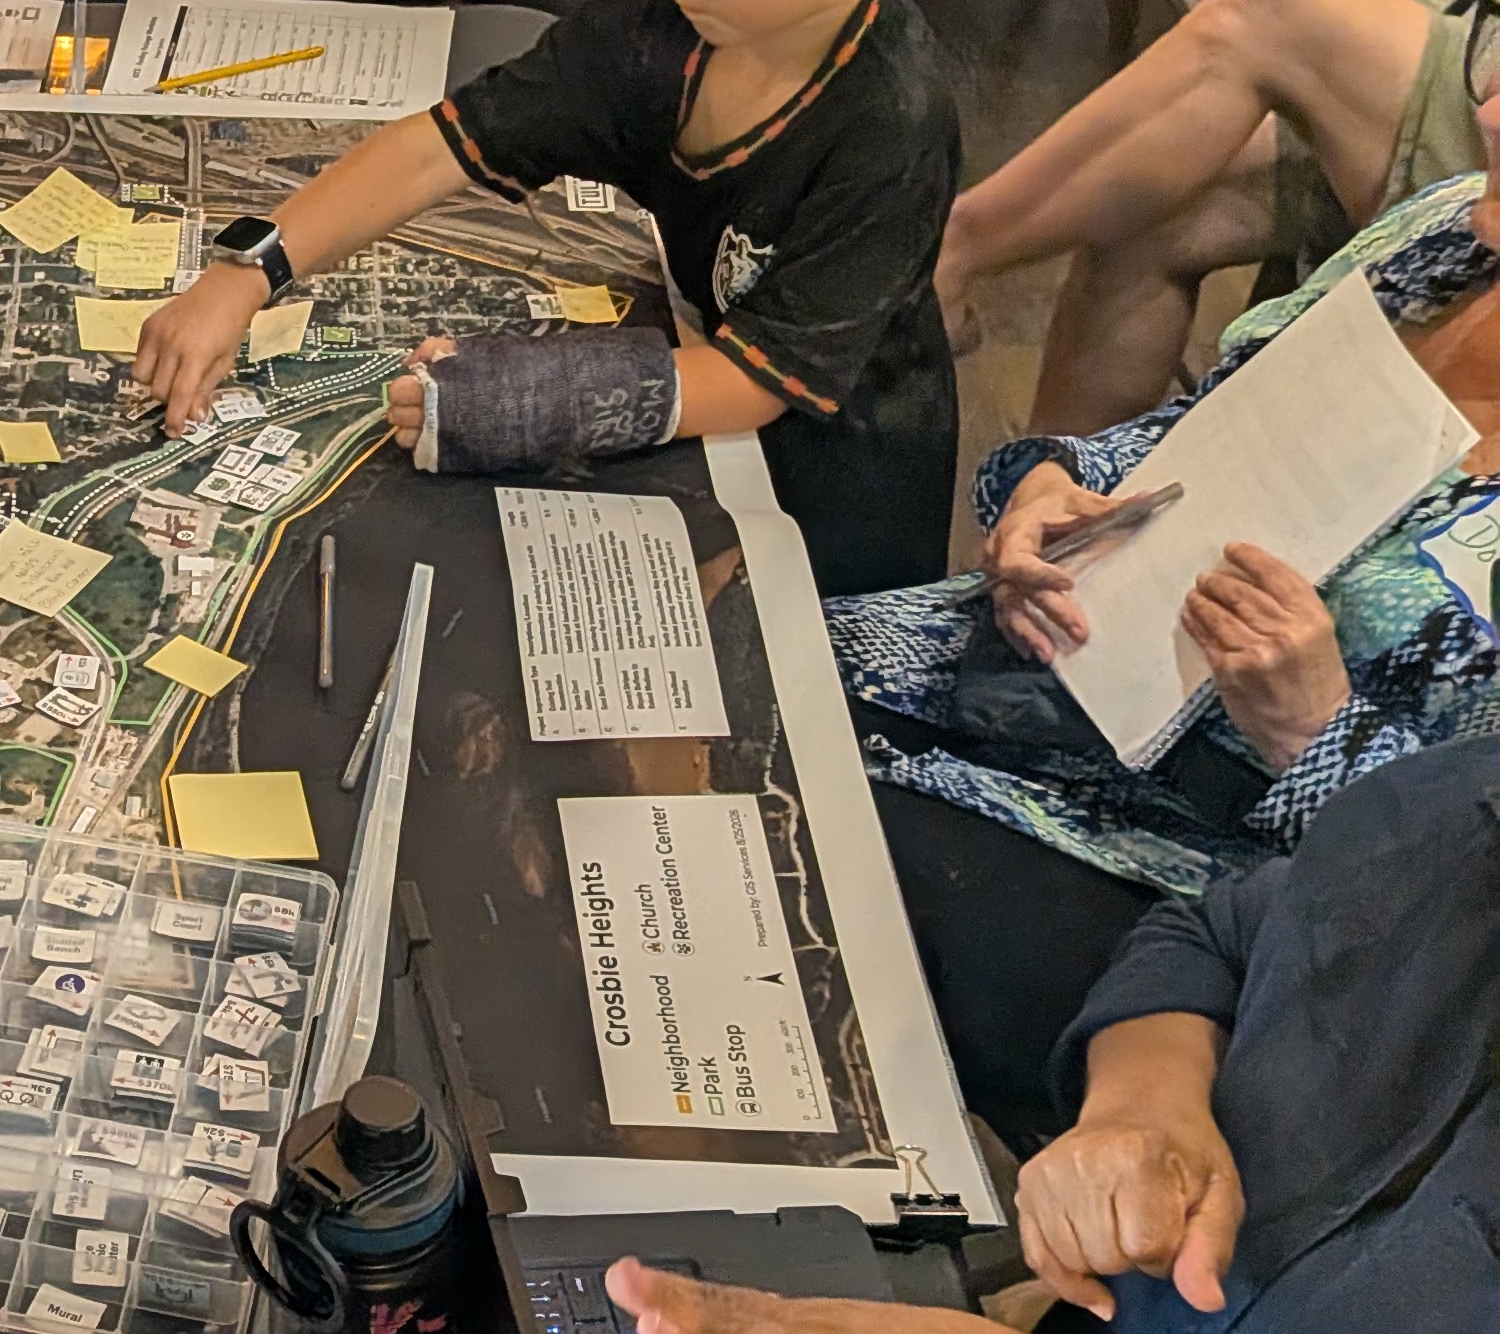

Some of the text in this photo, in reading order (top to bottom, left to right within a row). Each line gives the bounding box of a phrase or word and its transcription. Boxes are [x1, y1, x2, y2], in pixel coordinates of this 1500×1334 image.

[652, 806, 690, 940] Recreation Center
[739, 847, 753, 879] Services
[634, 884, 660, 939] Church
[751, 910, 768, 947] Prepared
[581, 862, 630, 1046] Crosbie Heights
[649, 975, 691, 1093] Neighborhood
[726, 1025, 755, 1097] Bus Stop
[697, 1057, 723, 1098] Park
[47, 1302, 83, 1324] Mural
